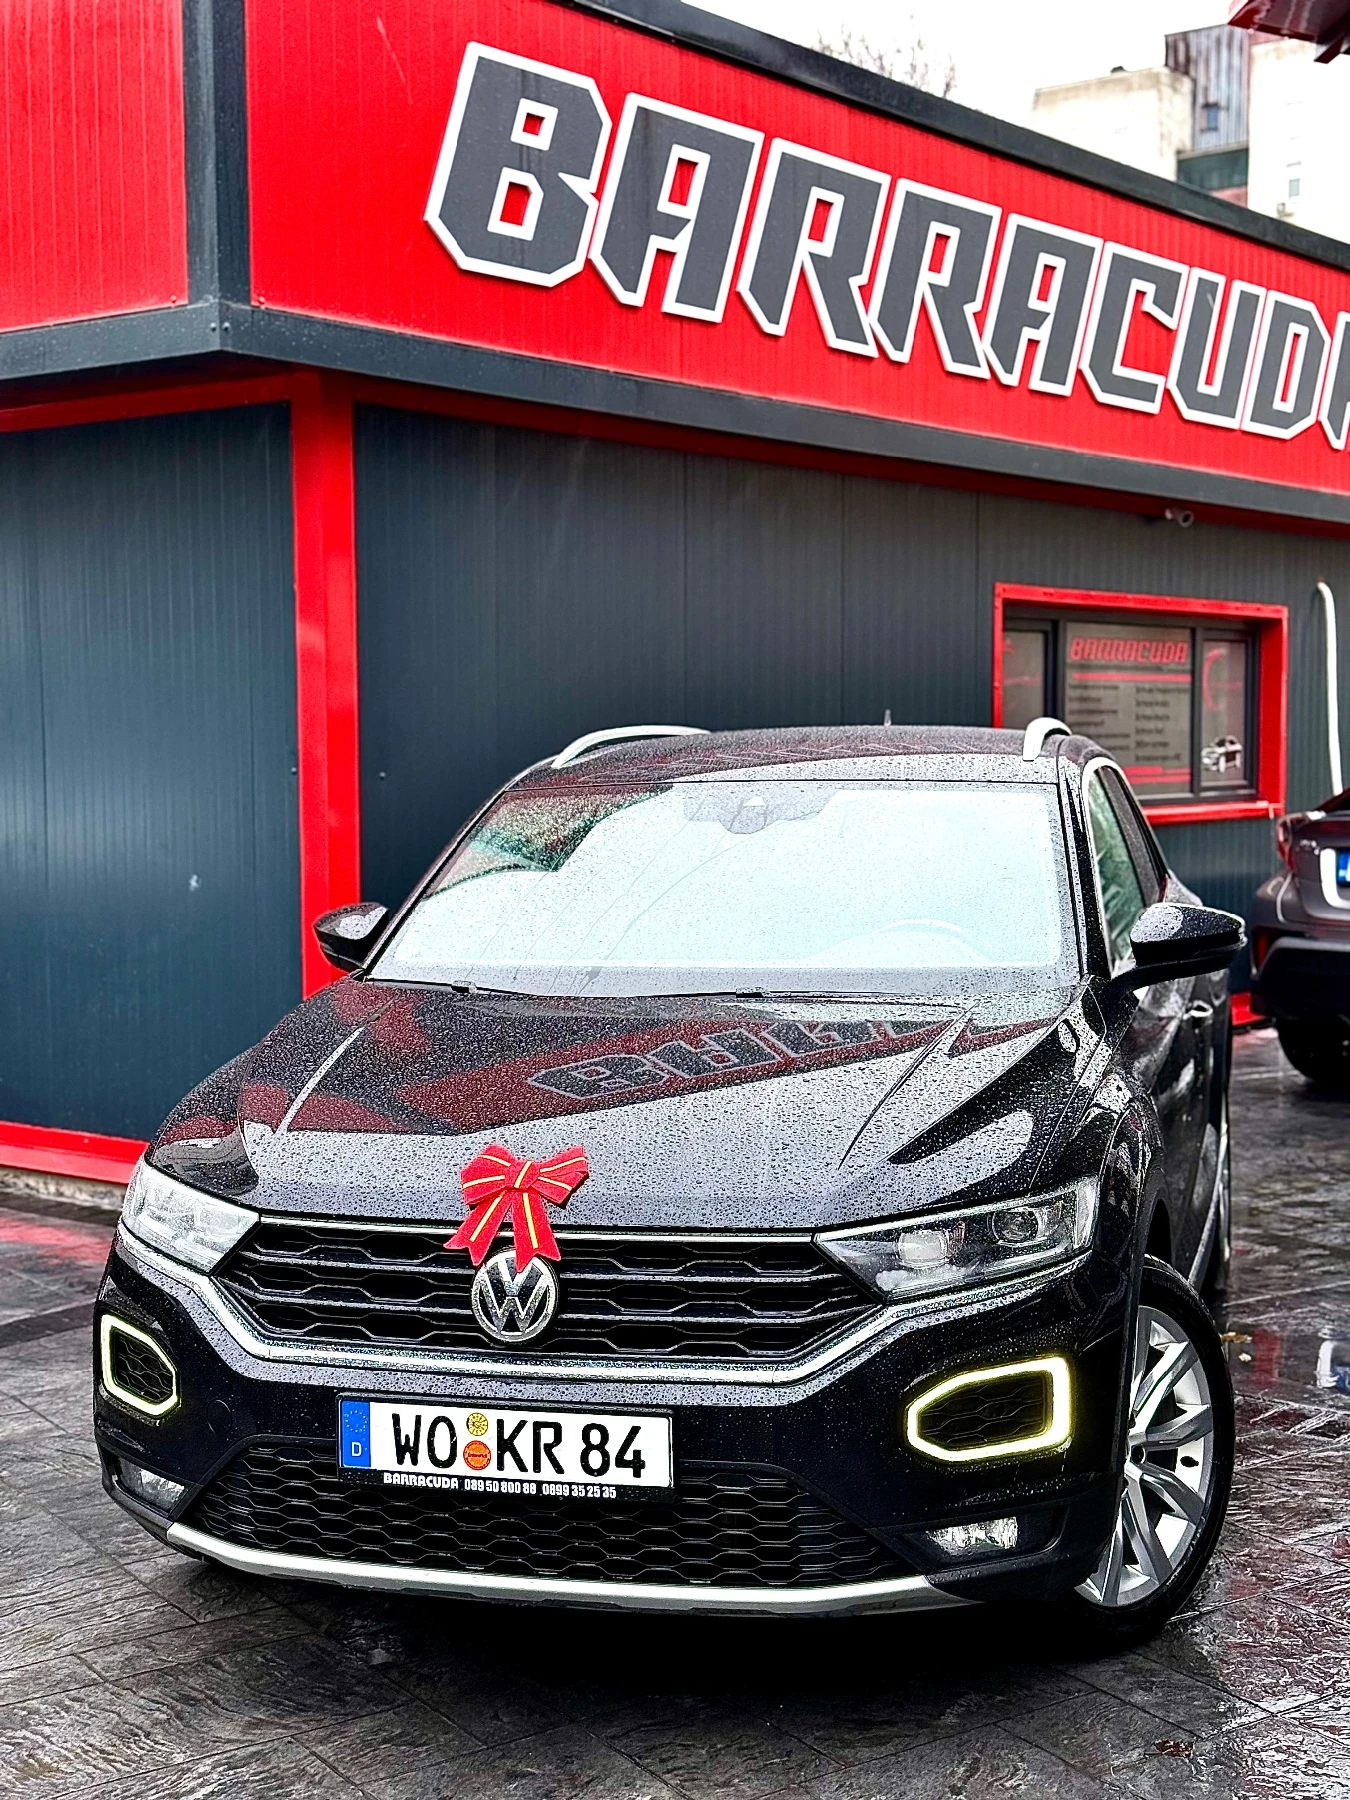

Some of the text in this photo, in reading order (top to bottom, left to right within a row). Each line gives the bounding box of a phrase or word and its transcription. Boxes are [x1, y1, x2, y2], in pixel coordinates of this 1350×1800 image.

[1070, 638, 1187, 662] BARRACUDA
[351, 1441, 362, 1457] D
[391, 1413, 457, 1469] WO
[496, 1418, 565, 1475] KR
[579, 1422, 646, 1478] 84
[383, 1472, 459, 1489] BARRACUDA
[542, 1483, 569, 1496] 0899
[571, 1485, 585, 1497] 35
[587, 1485, 600, 1498] 25
[602, 1486, 616, 1498] 35
